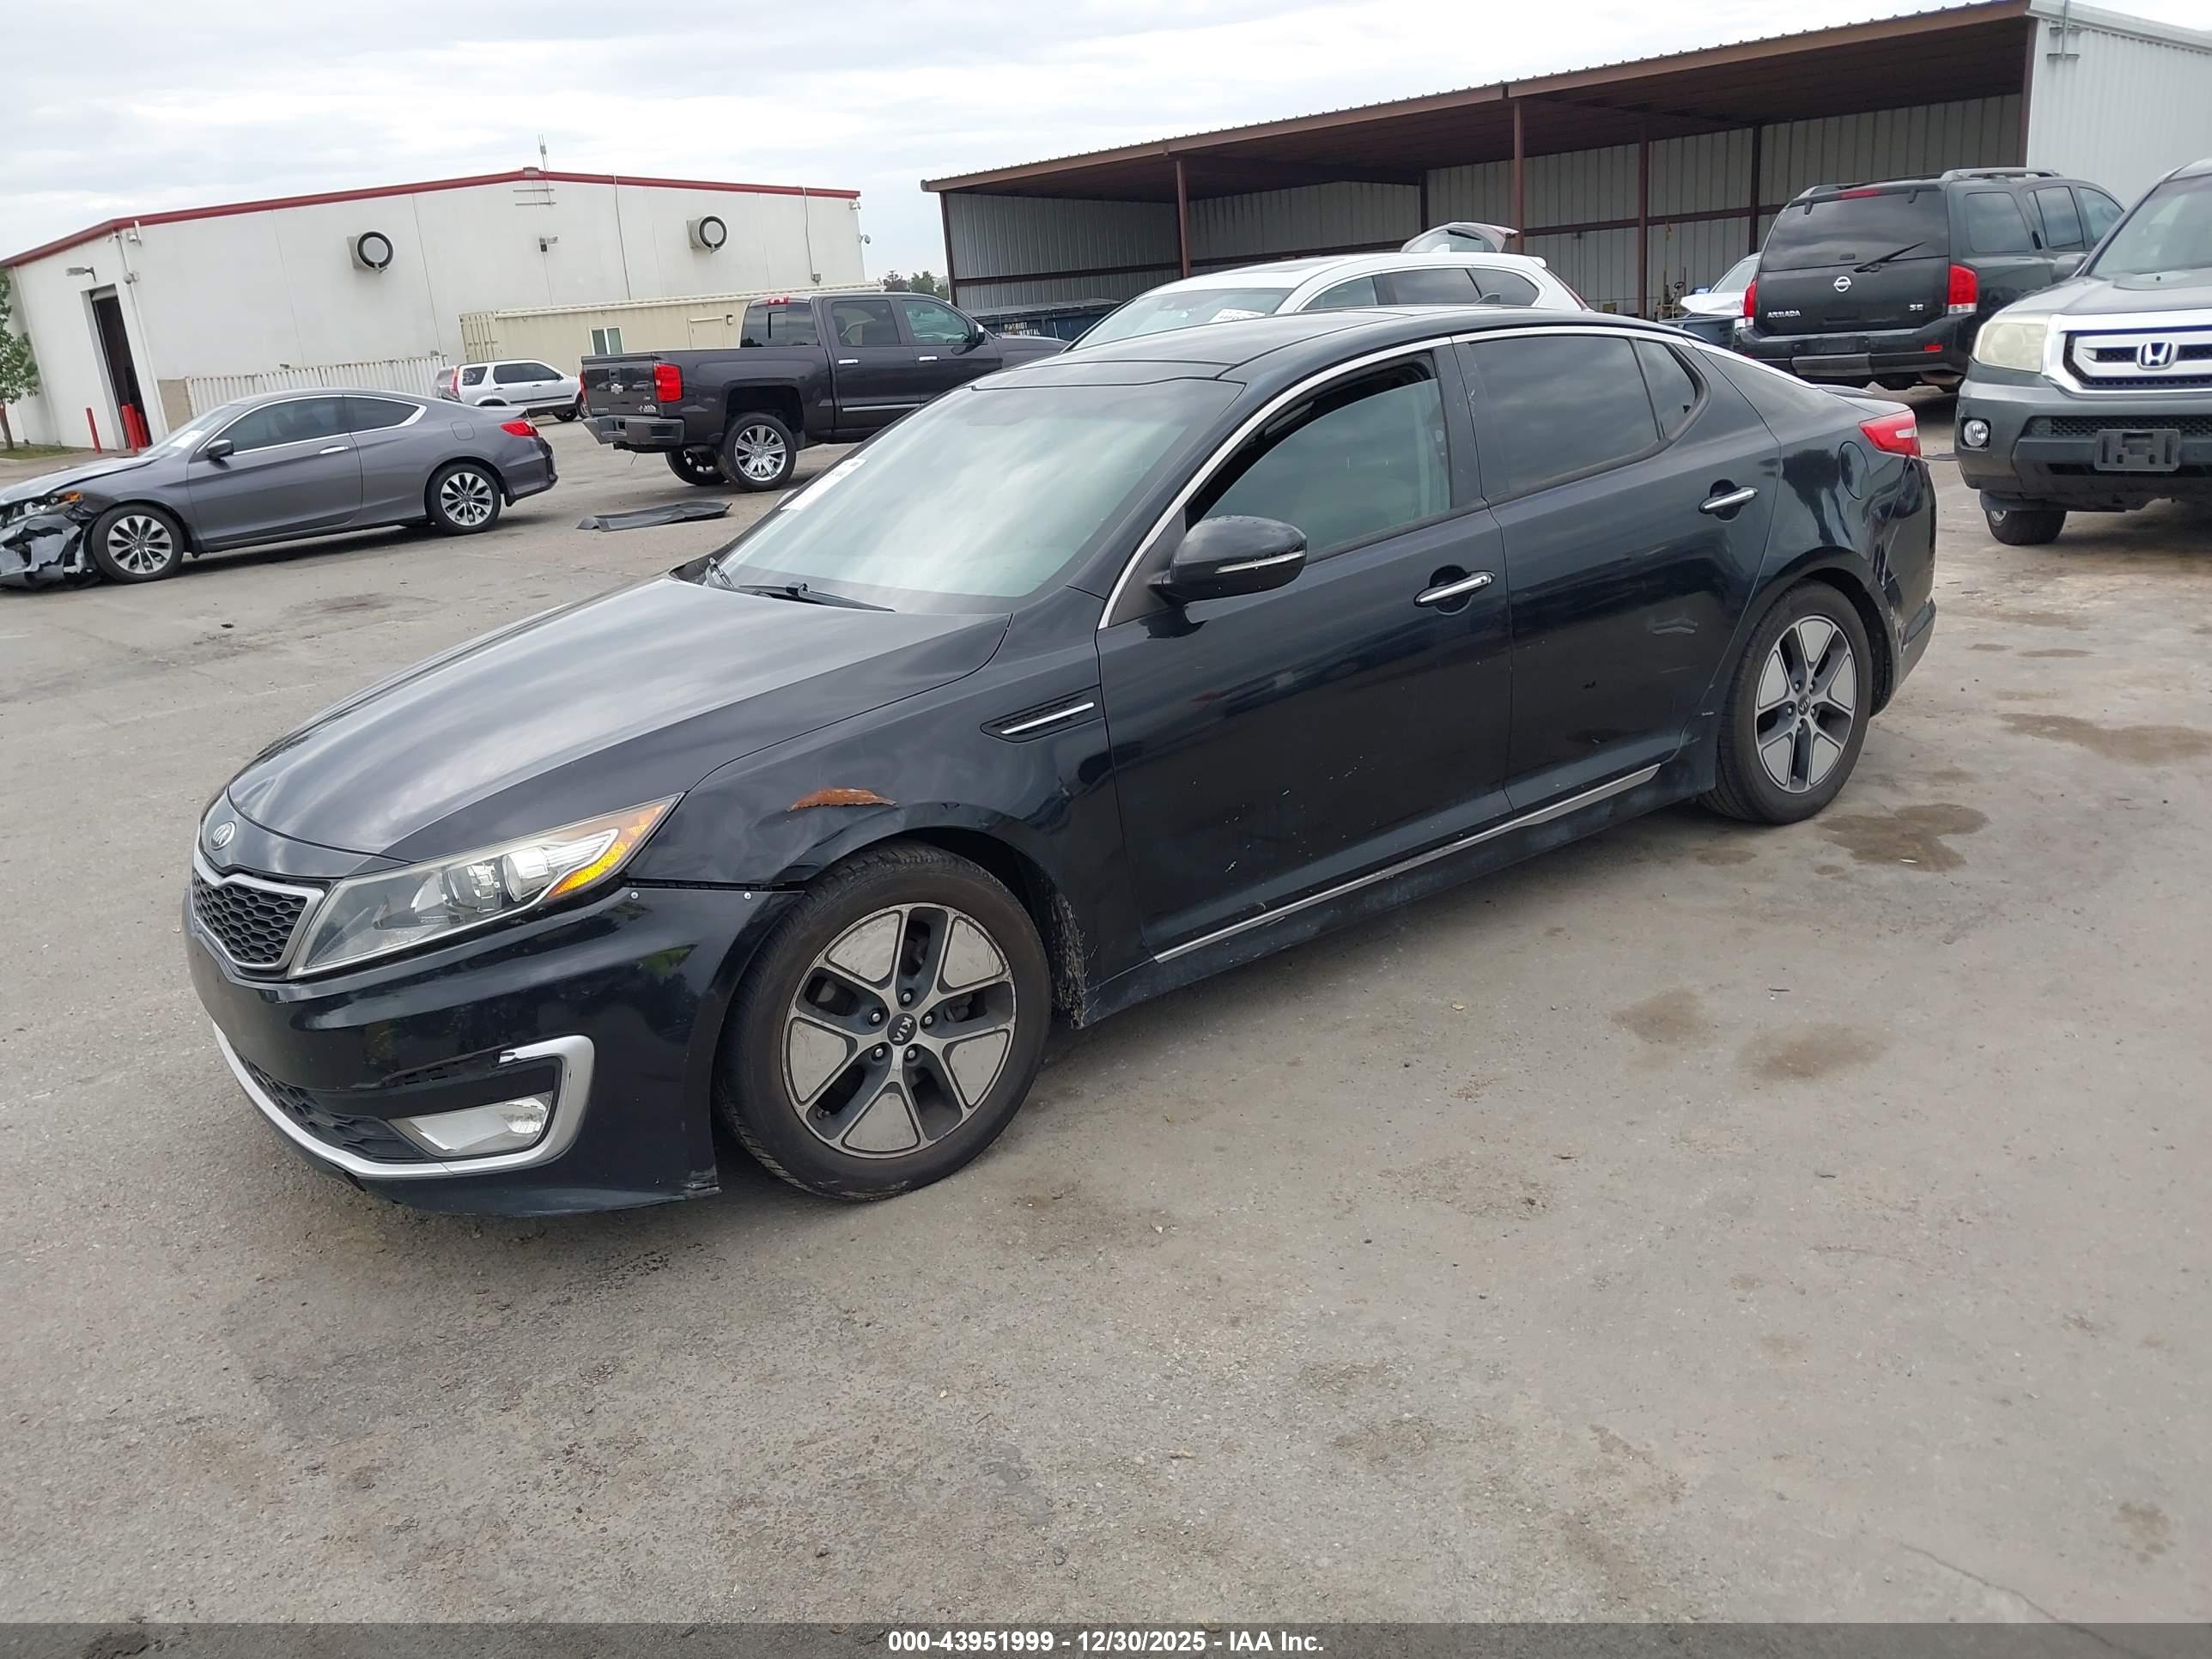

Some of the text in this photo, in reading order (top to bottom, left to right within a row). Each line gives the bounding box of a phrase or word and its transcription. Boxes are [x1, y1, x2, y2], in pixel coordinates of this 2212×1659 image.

[1909, 303, 1924, 312] SE
[1766, 309, 1802, 319] ARMADA
[1004, 321, 1028, 331] PATRIOT
[893, 1016, 913, 1042] KIA
